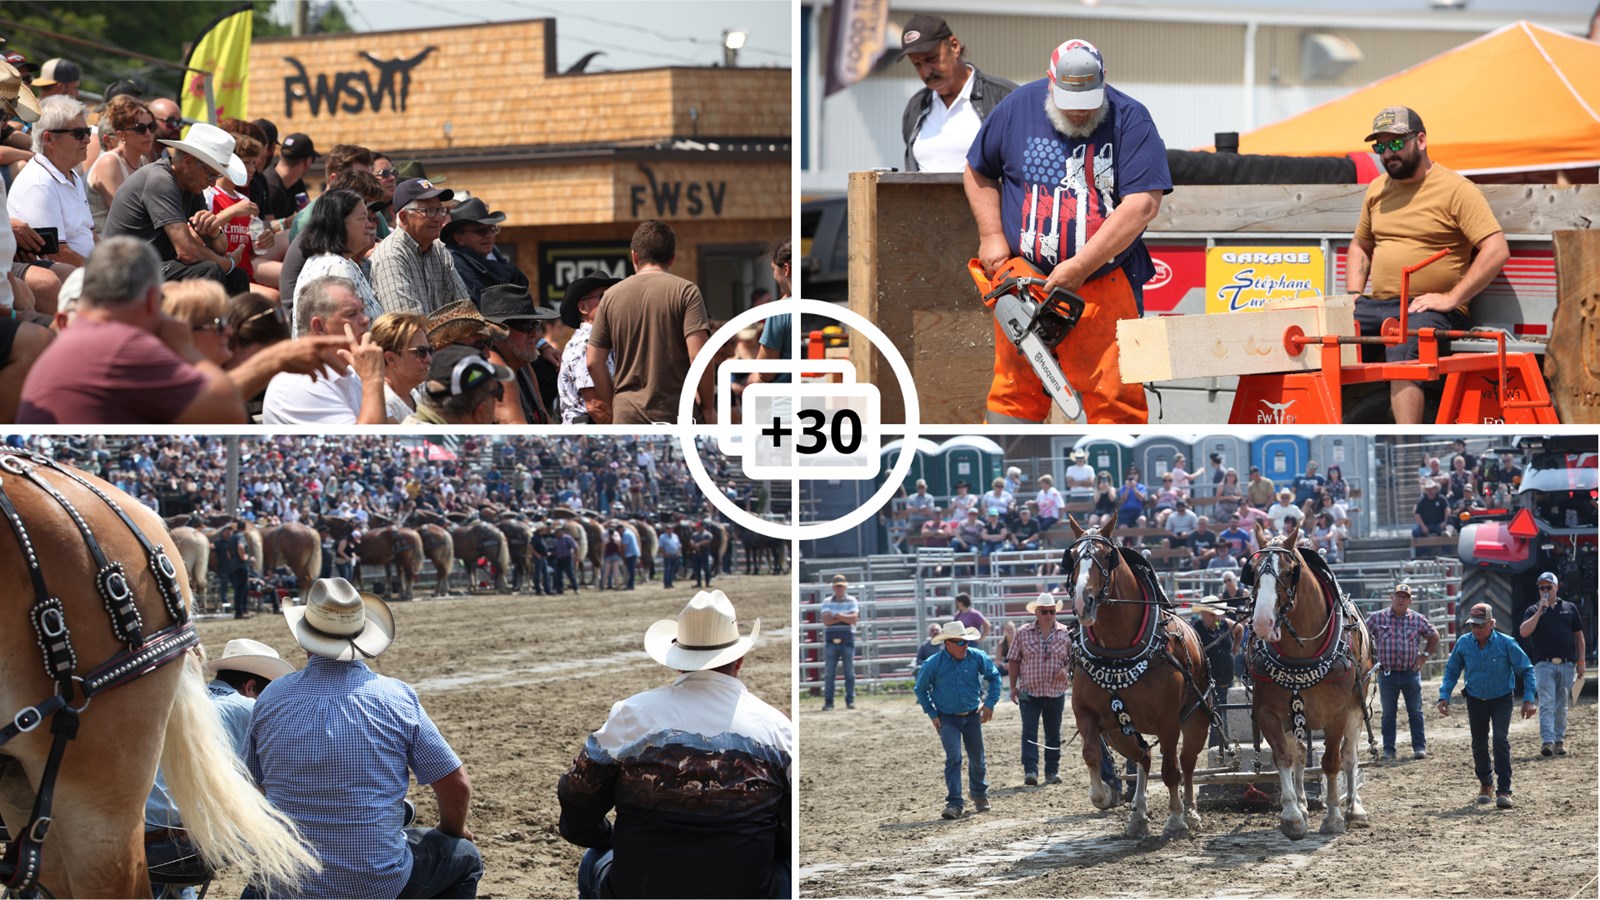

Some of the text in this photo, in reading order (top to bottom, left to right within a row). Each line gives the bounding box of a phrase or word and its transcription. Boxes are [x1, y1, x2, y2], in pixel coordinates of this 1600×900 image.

[630, 163, 727, 217] FWSV
[1222, 253, 1310, 264] GARAGE
[1234, 269, 1311, 294] Stéphane
[1039, 359, 1061, 392] Husqvarna
[1082, 660, 1149, 683] CLOUTIER
[1269, 665, 1328, 684] LESSARD
